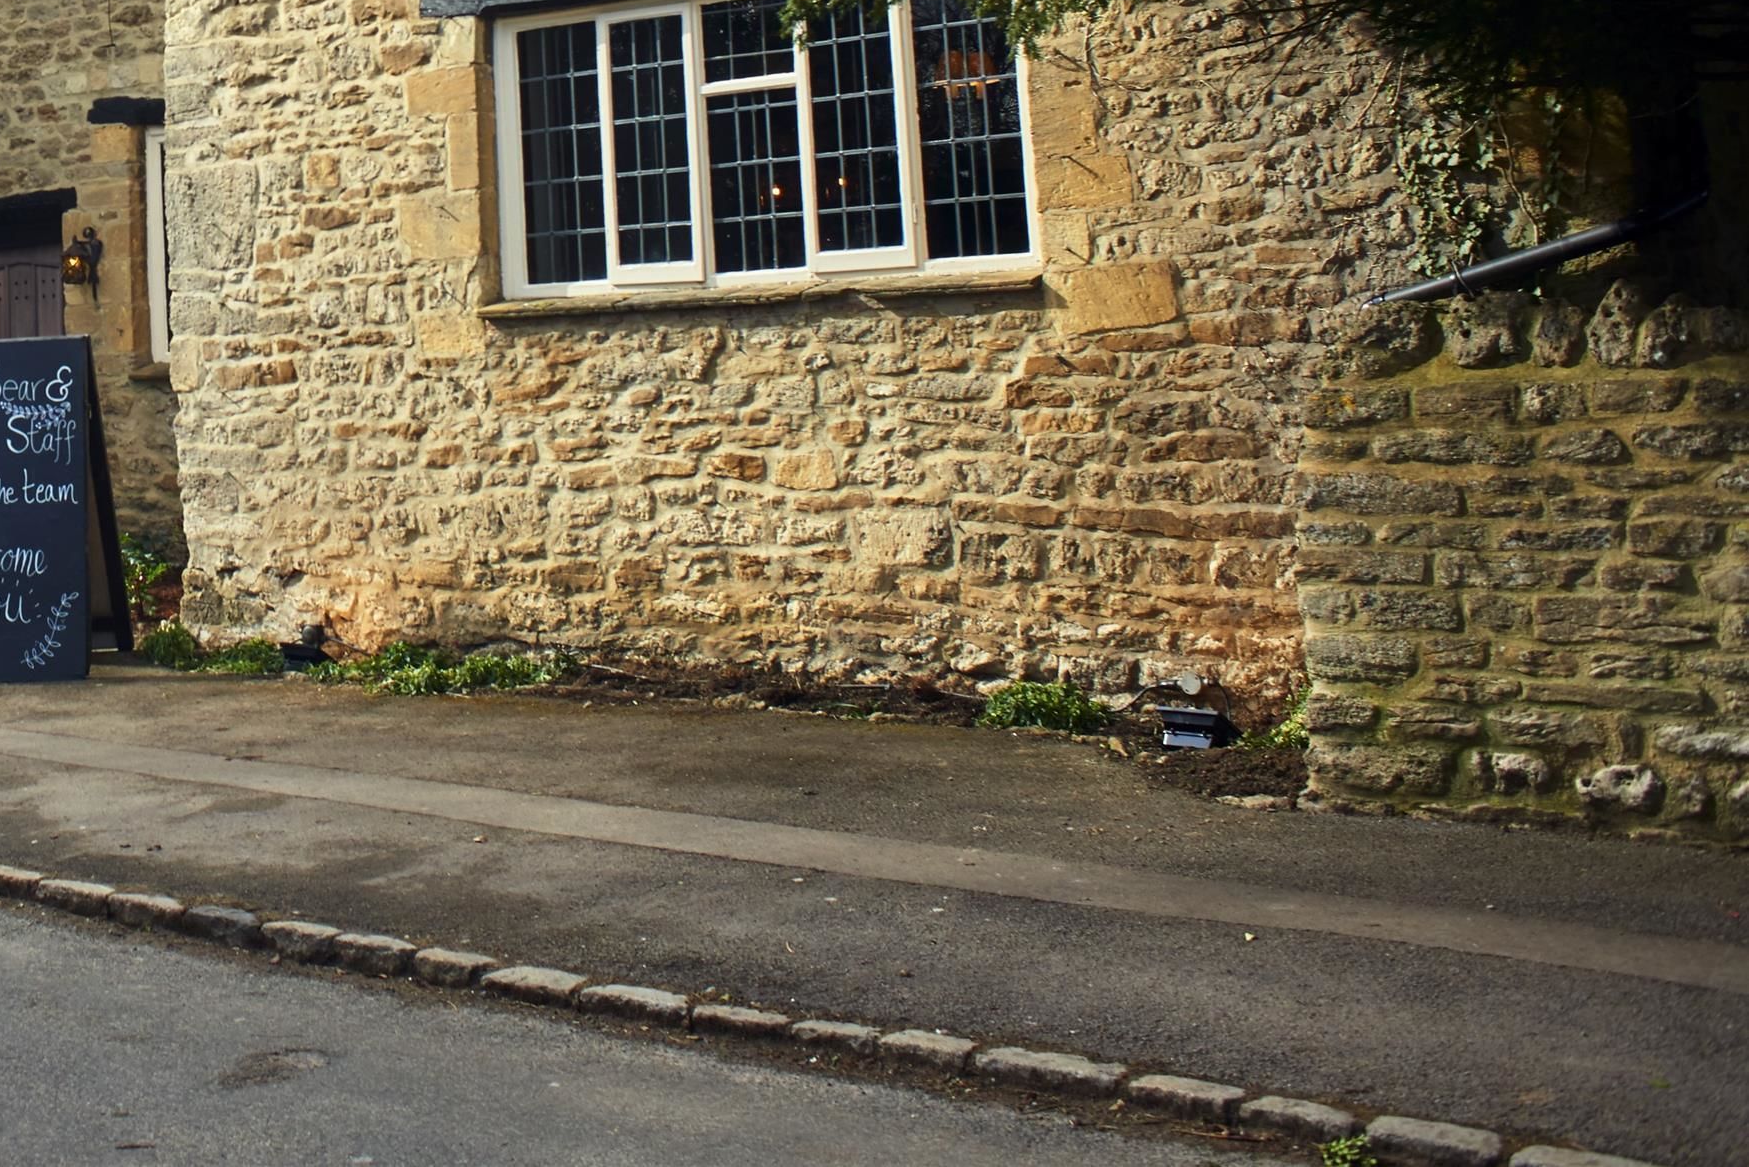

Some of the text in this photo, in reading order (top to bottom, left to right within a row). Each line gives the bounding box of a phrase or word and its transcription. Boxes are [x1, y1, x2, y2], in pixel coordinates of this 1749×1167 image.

[45, 365, 73, 402] &
[6, 414, 76, 465] Staff
[22, 468, 79, 505] team
